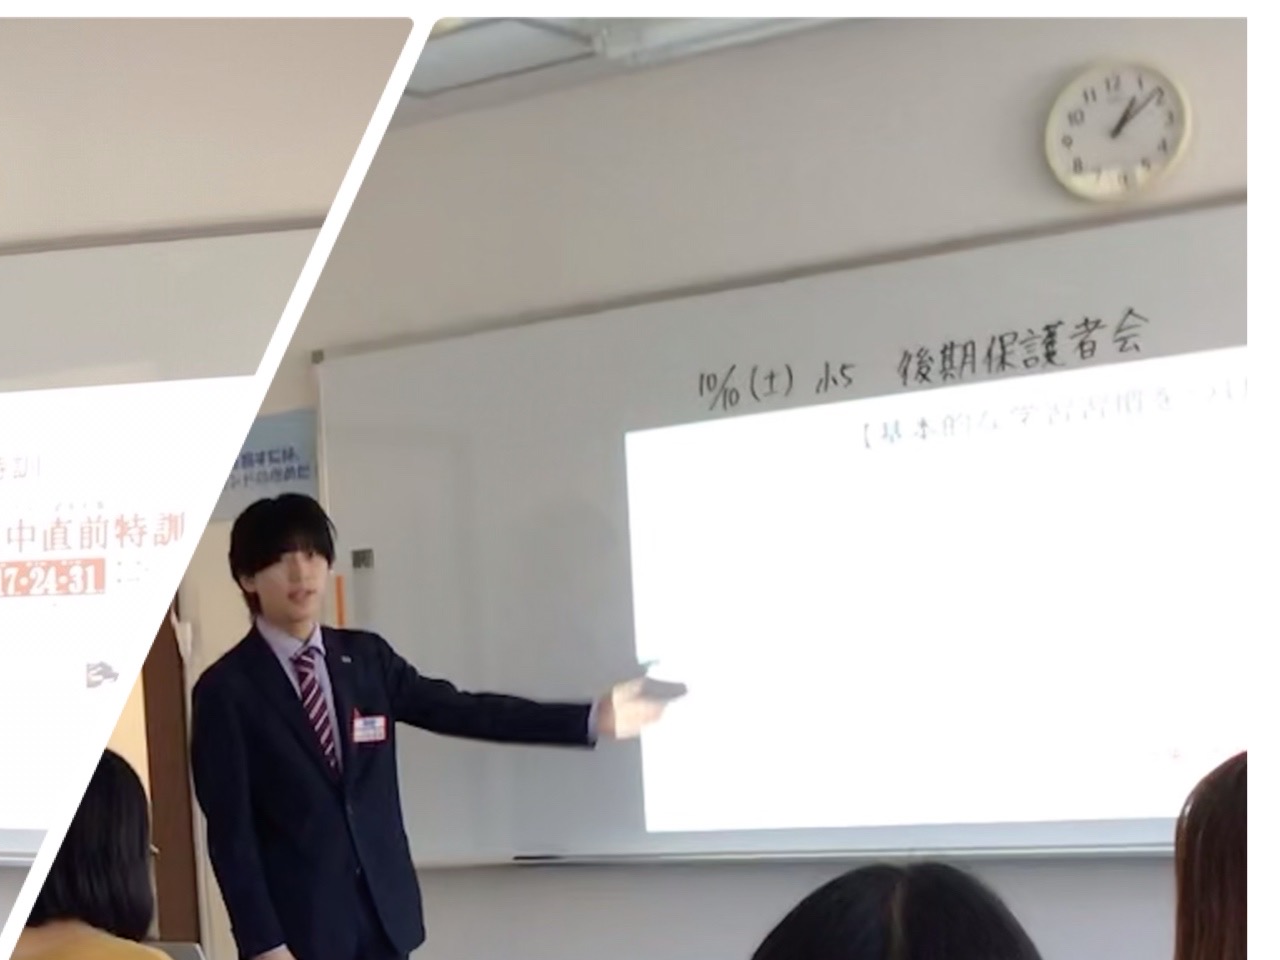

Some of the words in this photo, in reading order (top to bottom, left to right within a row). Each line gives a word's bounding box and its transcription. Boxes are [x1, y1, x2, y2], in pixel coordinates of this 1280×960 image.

[1082, 87, 1097, 103] 11
[1067, 109, 1085, 127] 10
[897, 306, 1150, 386] 後期保護者会
